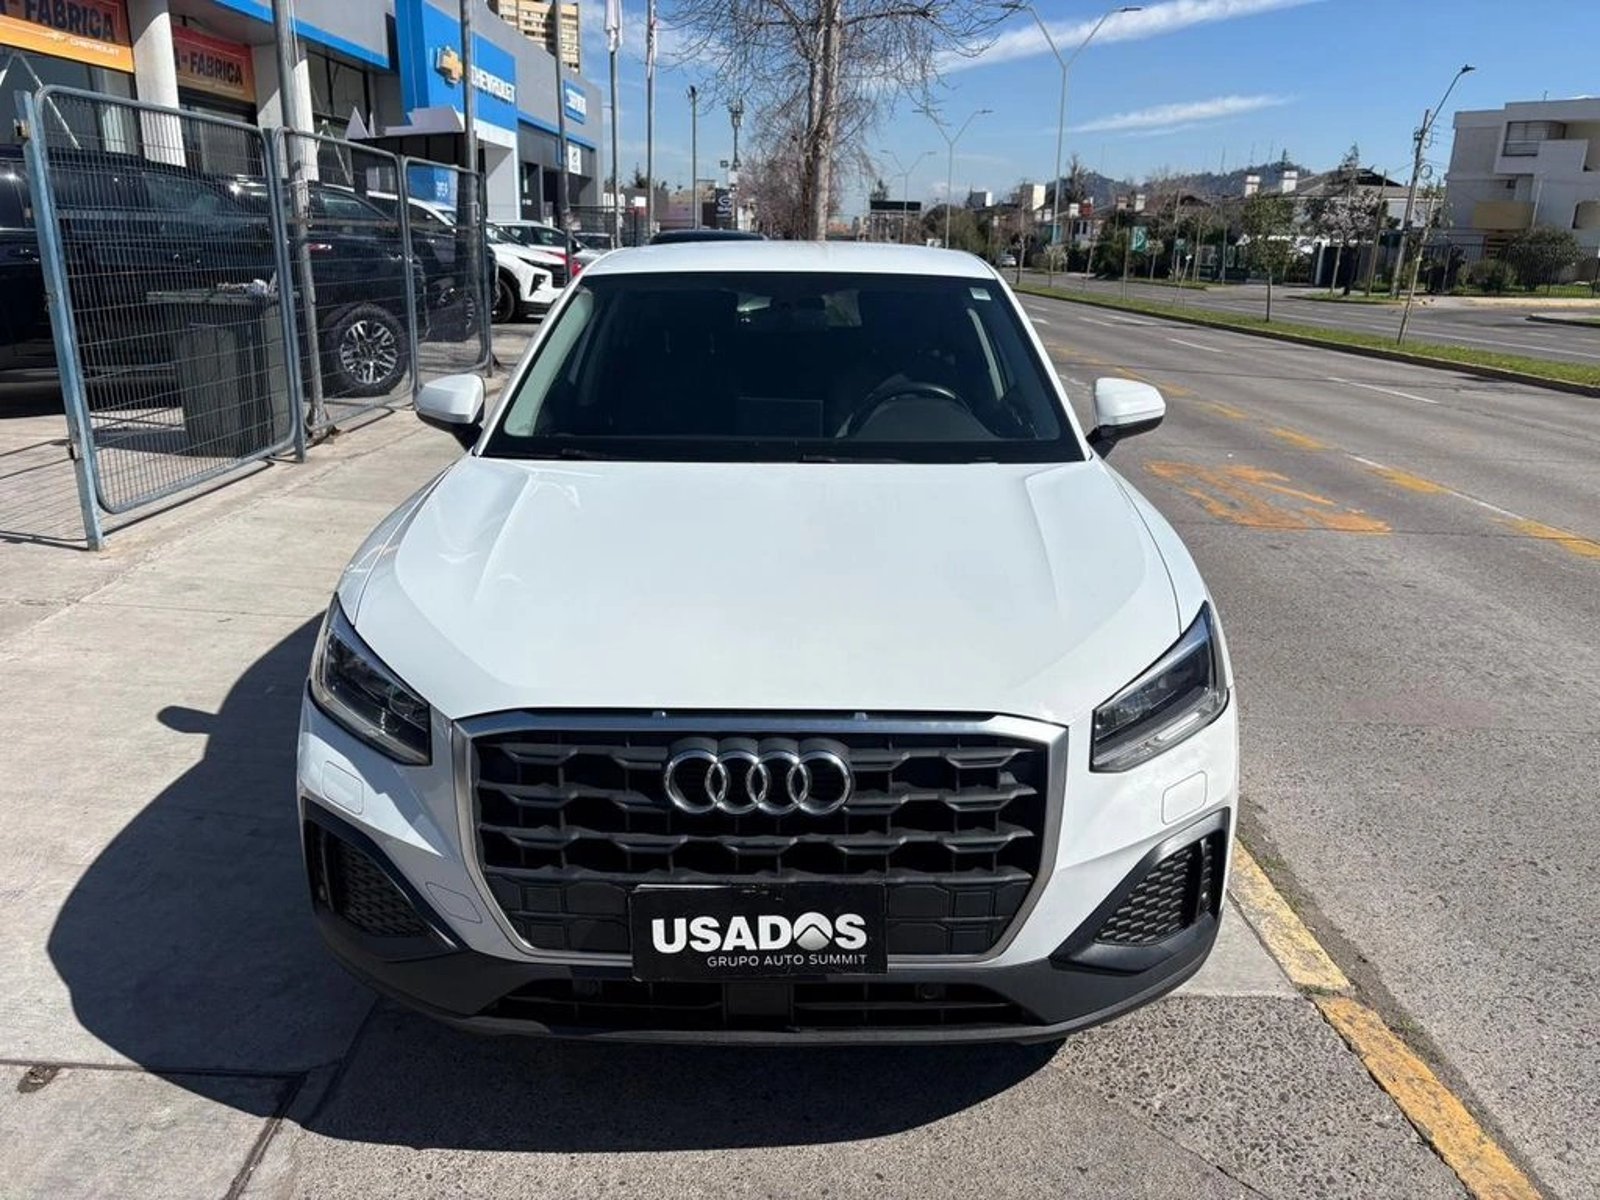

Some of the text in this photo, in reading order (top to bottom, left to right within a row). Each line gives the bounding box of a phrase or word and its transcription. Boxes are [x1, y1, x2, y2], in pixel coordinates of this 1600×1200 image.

[651, 911, 867, 953] USADOS
[706, 954, 868, 967] GRUPO AUTO SUMMIT
